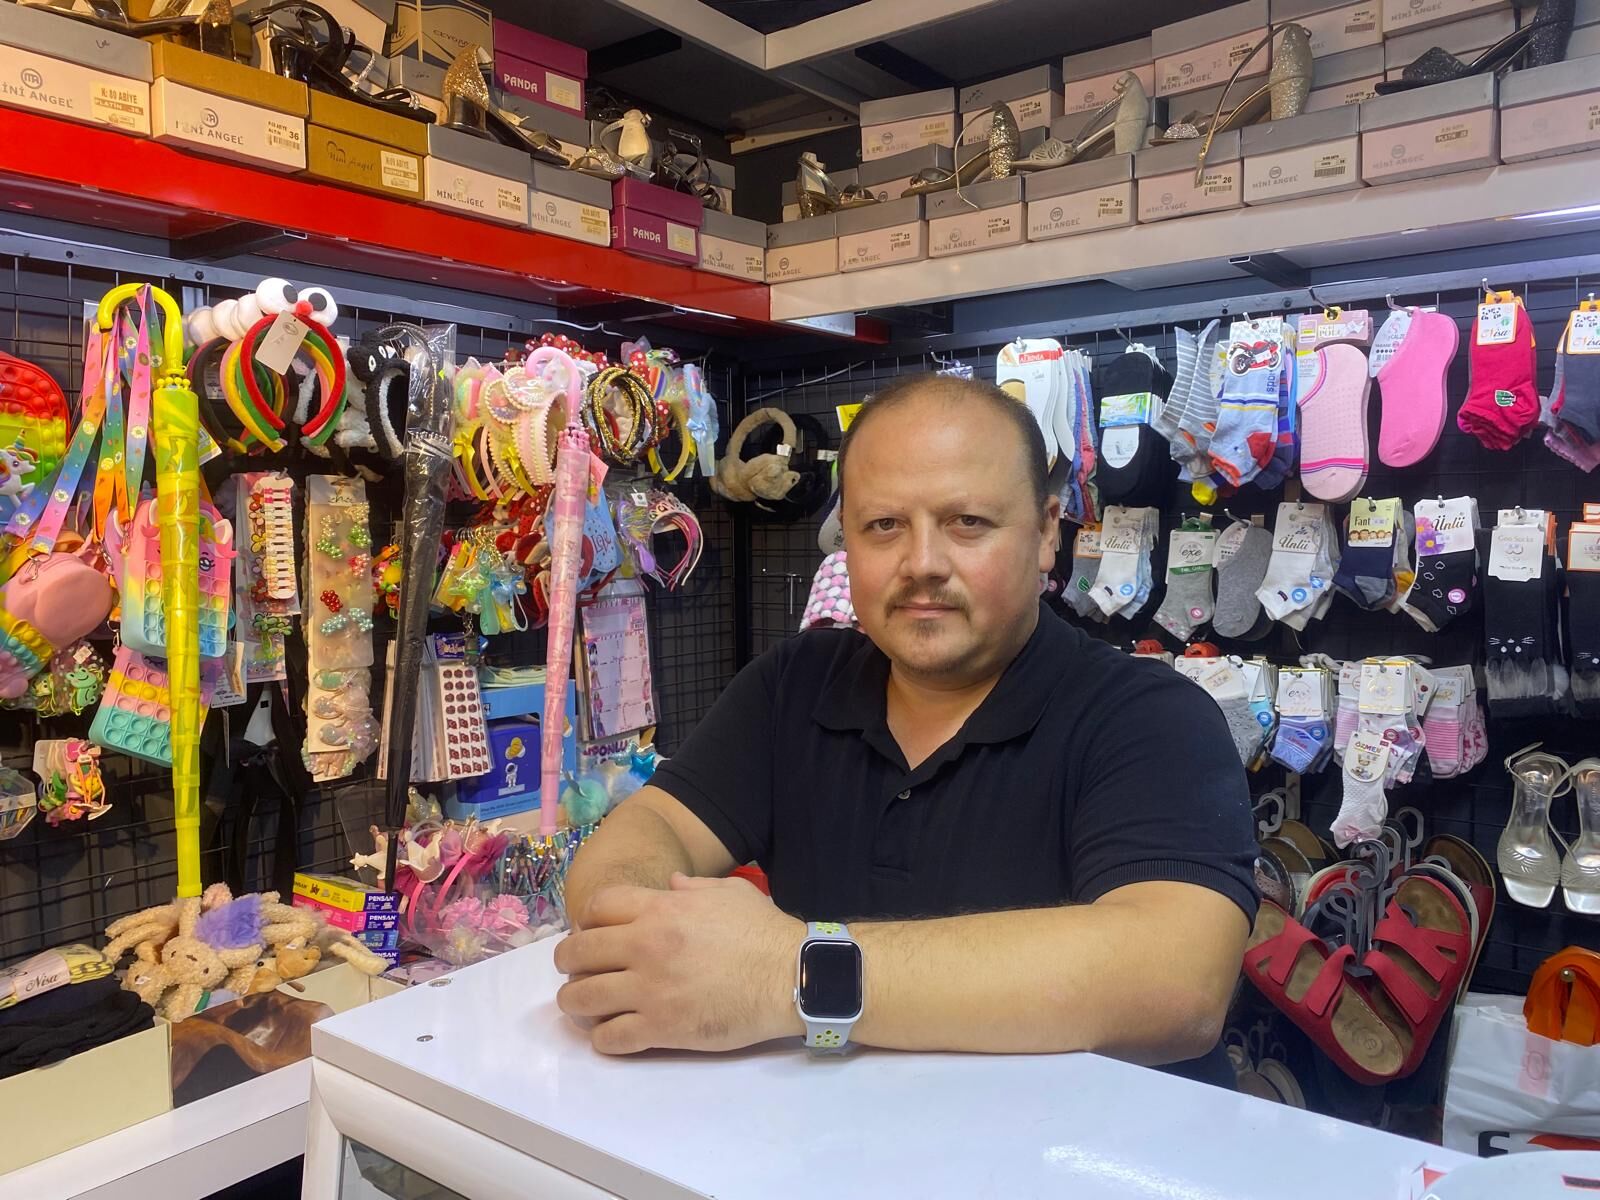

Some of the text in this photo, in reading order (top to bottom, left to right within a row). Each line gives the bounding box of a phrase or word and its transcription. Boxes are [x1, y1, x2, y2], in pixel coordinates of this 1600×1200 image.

[1414, 3, 1442, 16] ANGEL
[503, 73, 538, 93] PANDA
[30, 90, 73, 109] ANGEL
[207, 128, 244, 145] ANGEL
[289, 131, 300, 140] 36
[1222, 176, 1232, 184] 26
[550, 217, 572, 228] ANGEL
[1002, 218, 1010, 226] 34
[1054, 217, 1080, 229] ANGEL
[632, 227, 661, 243] PANDA
[953, 239, 977, 249] ANGEL
[782, 268, 801, 277] ANGEL
[1430, 514, 1466, 532] Ünlü
[1104, 535, 1133, 550] Ünlü
[1278, 534, 1311, 550] Ünlü
[1181, 548, 1202, 560] exe
[25, 973, 59, 992] Nisa
